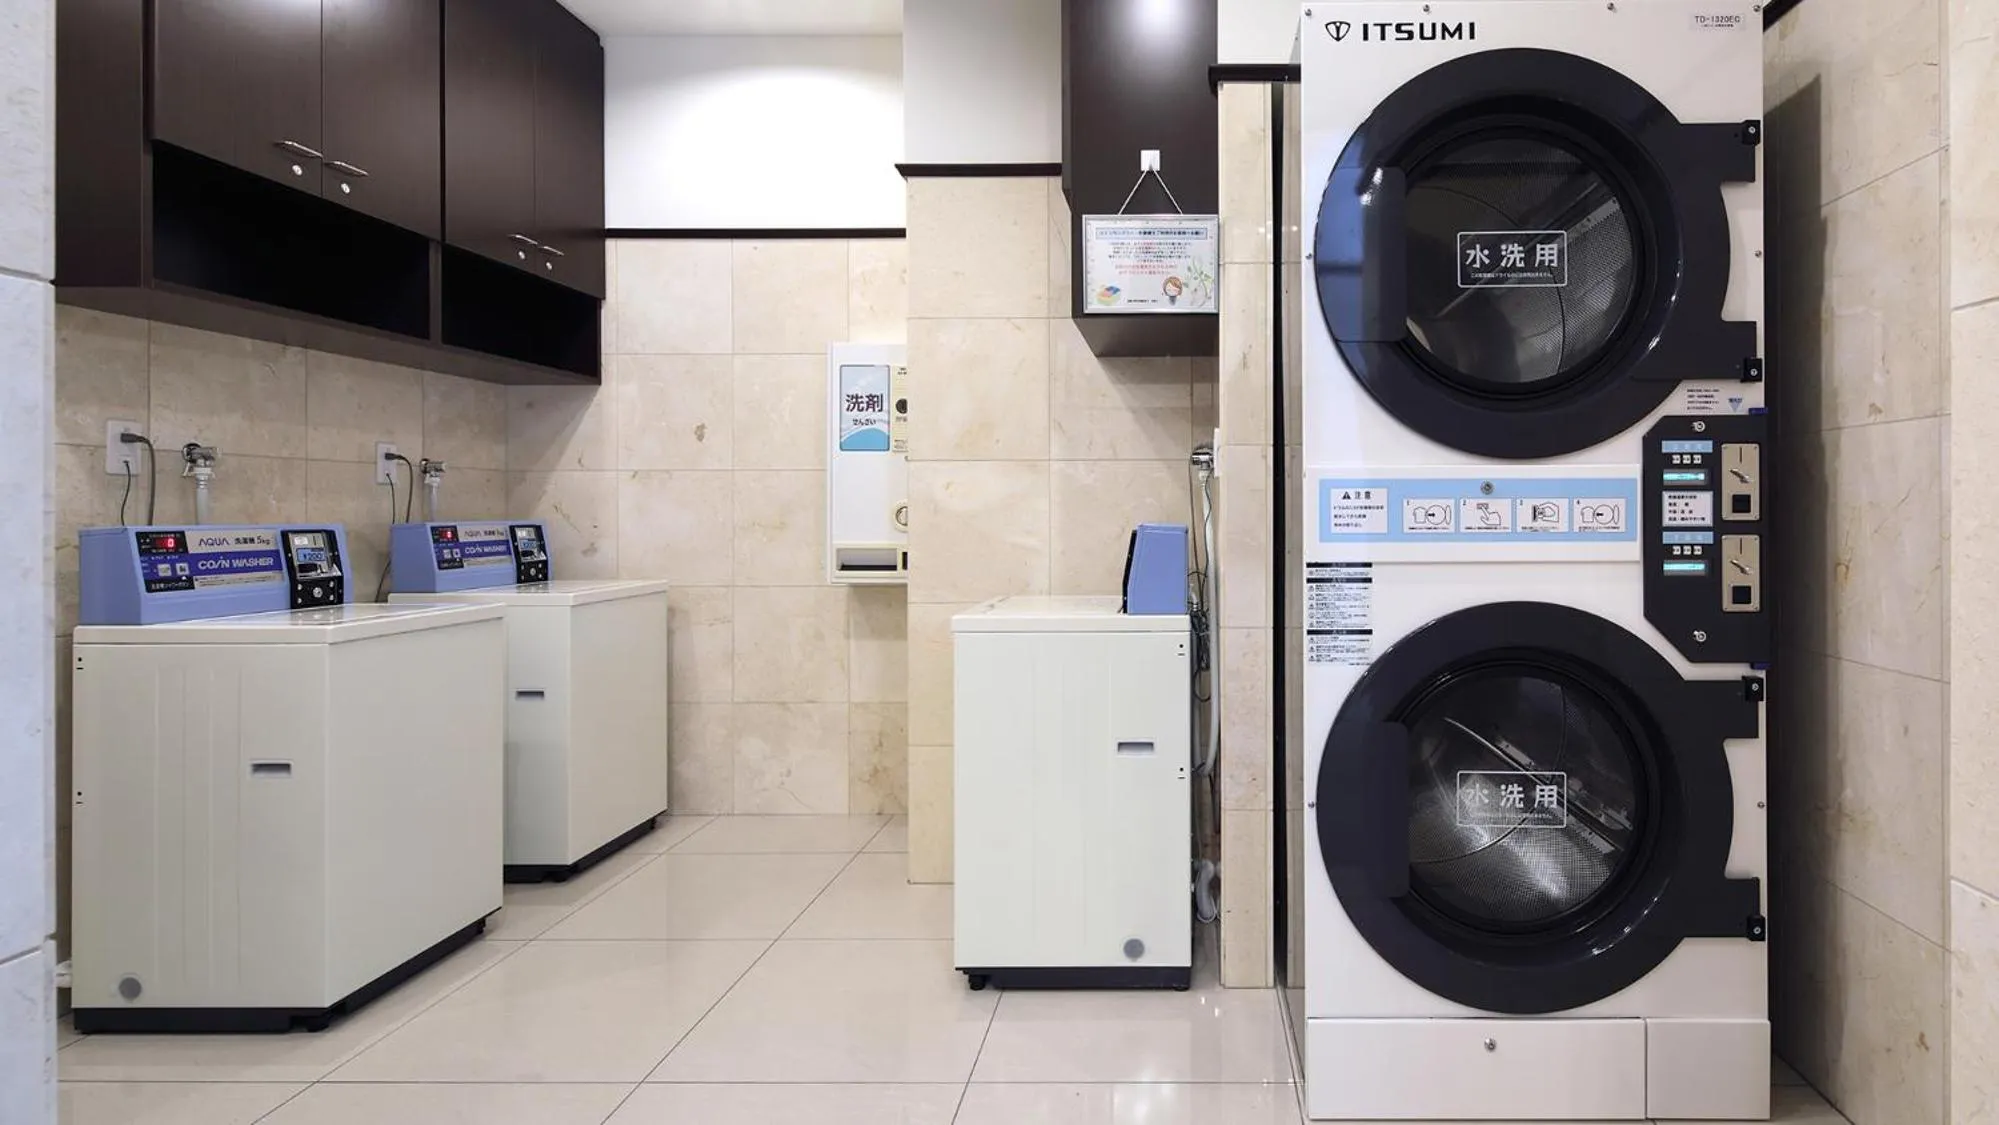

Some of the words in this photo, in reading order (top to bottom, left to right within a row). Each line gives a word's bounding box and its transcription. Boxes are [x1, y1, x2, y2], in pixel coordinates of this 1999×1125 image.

[1362, 22, 1476, 41] ITSUMI
[1465, 243, 1559, 269] 水洗用
[845, 393, 884, 413] 洗剤
[852, 418, 877, 426] せんざい
[1354, 490, 1371, 500] 注意
[167, 537, 175, 548] 0
[198, 537, 231, 547] AQUA
[257, 535, 271, 546] 5kg
[232, 556, 274, 568] WASHER
[1465, 783, 1559, 809] 水洗用
